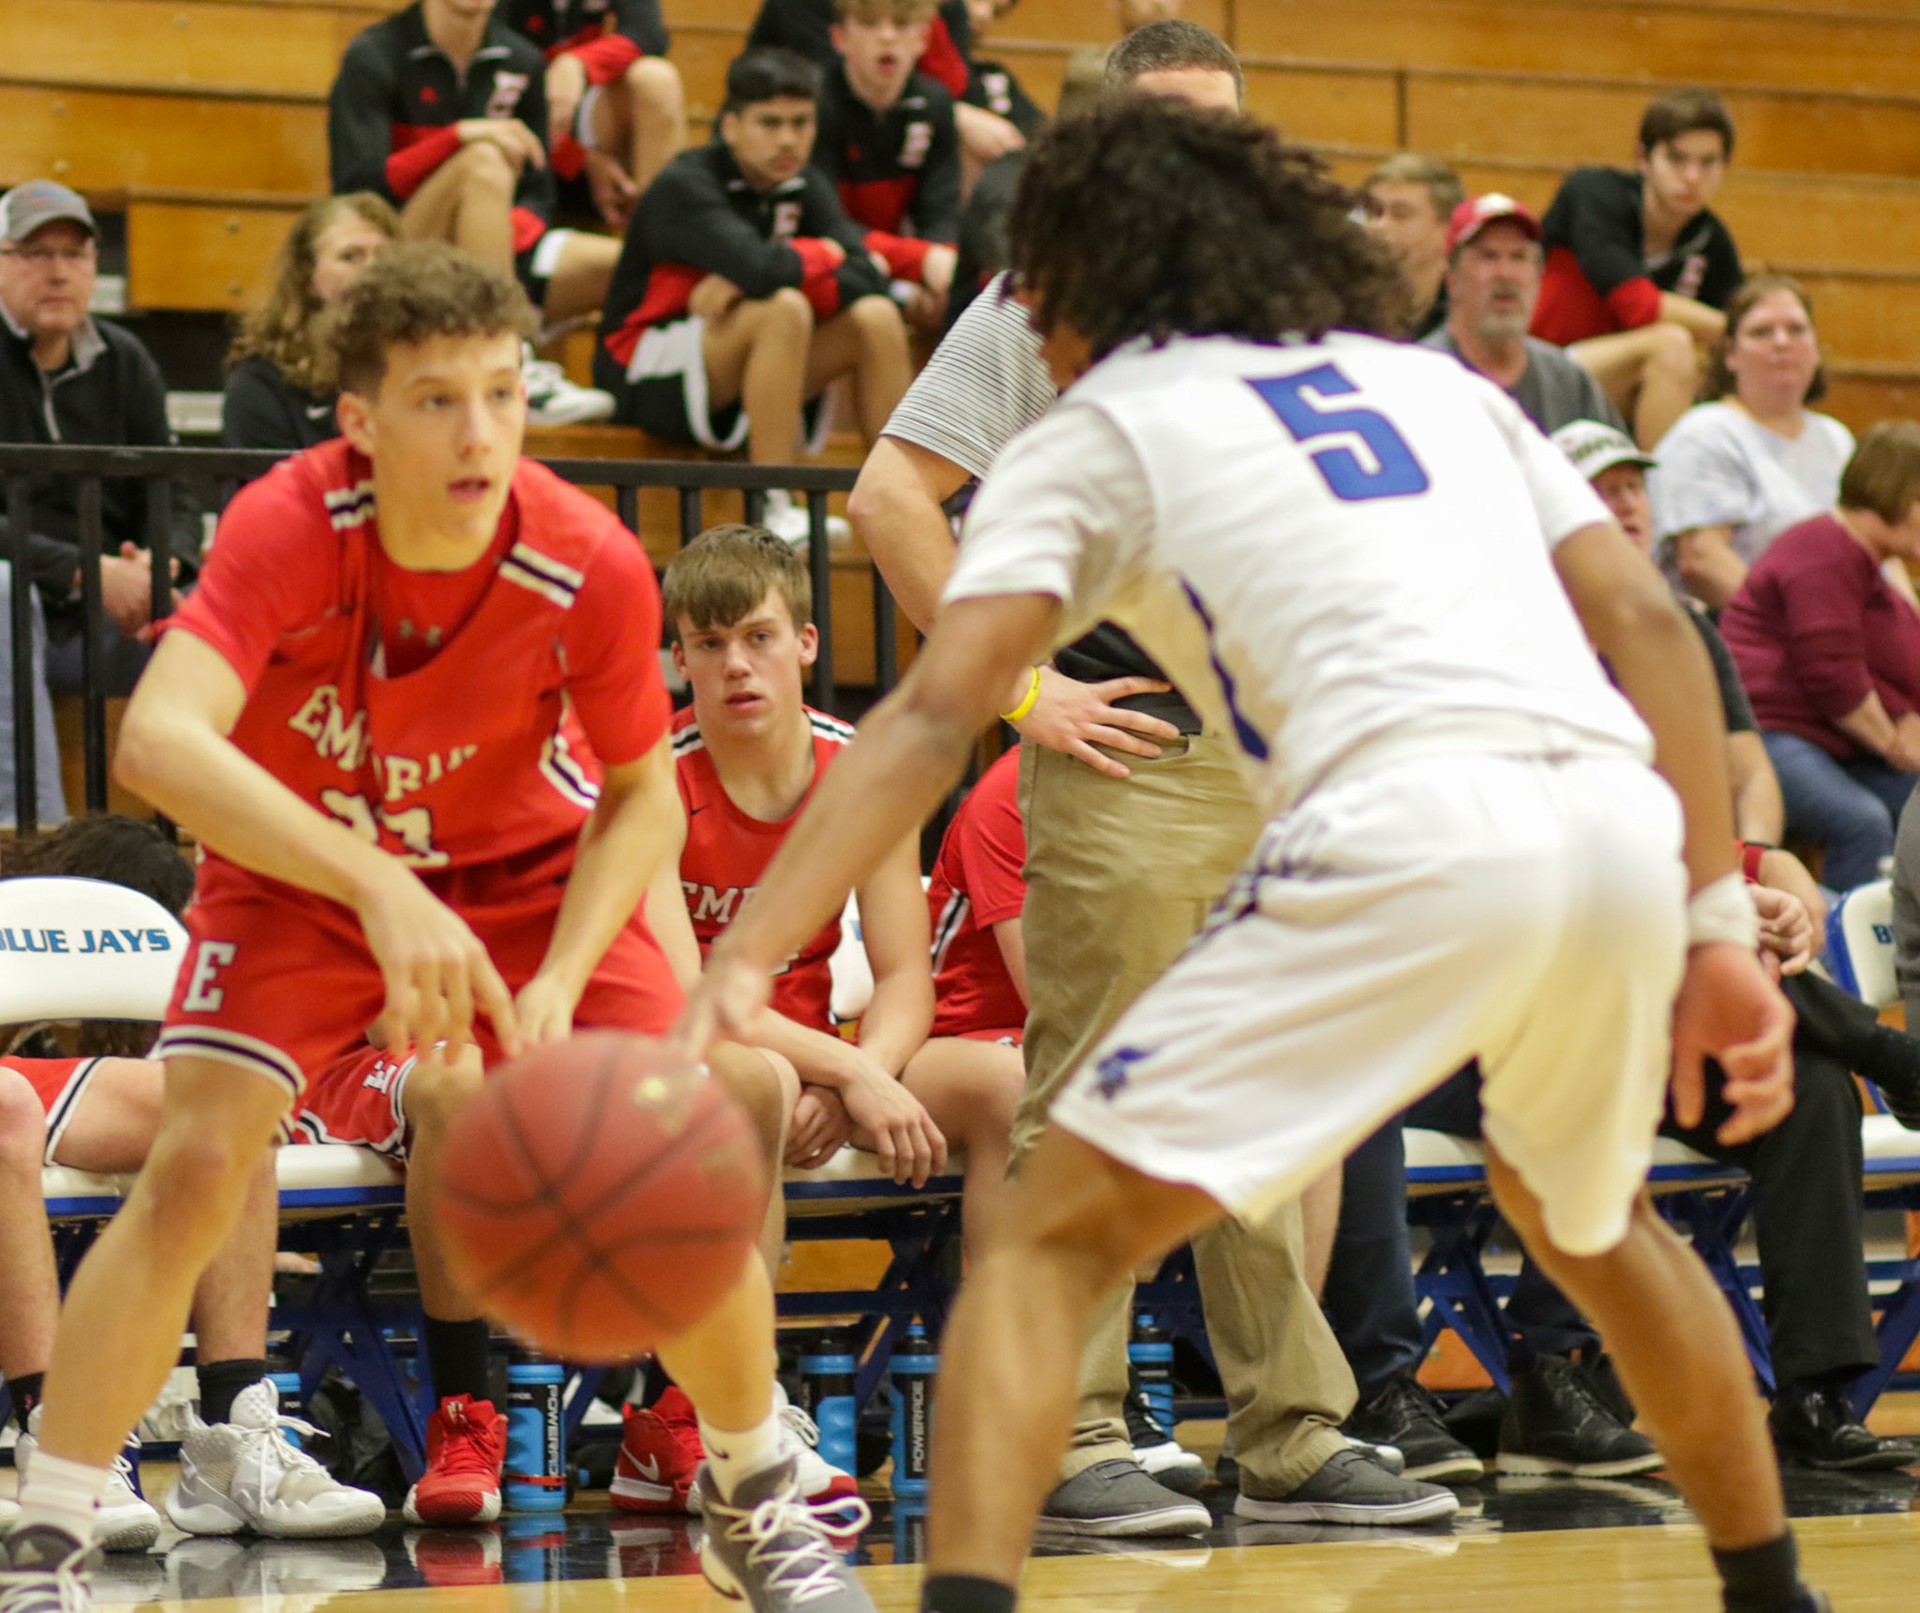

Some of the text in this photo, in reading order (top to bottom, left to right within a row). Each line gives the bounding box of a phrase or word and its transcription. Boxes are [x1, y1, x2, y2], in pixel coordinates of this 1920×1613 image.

[1240, 362, 1431, 502] 5
[0, 928, 171, 953] LUE JAYS
[182, 940, 237, 1013] E
[362, 1059, 398, 1096] E
[547, 1384, 559, 1491] POWERAD
[911, 1380, 925, 1473] POWERADE
